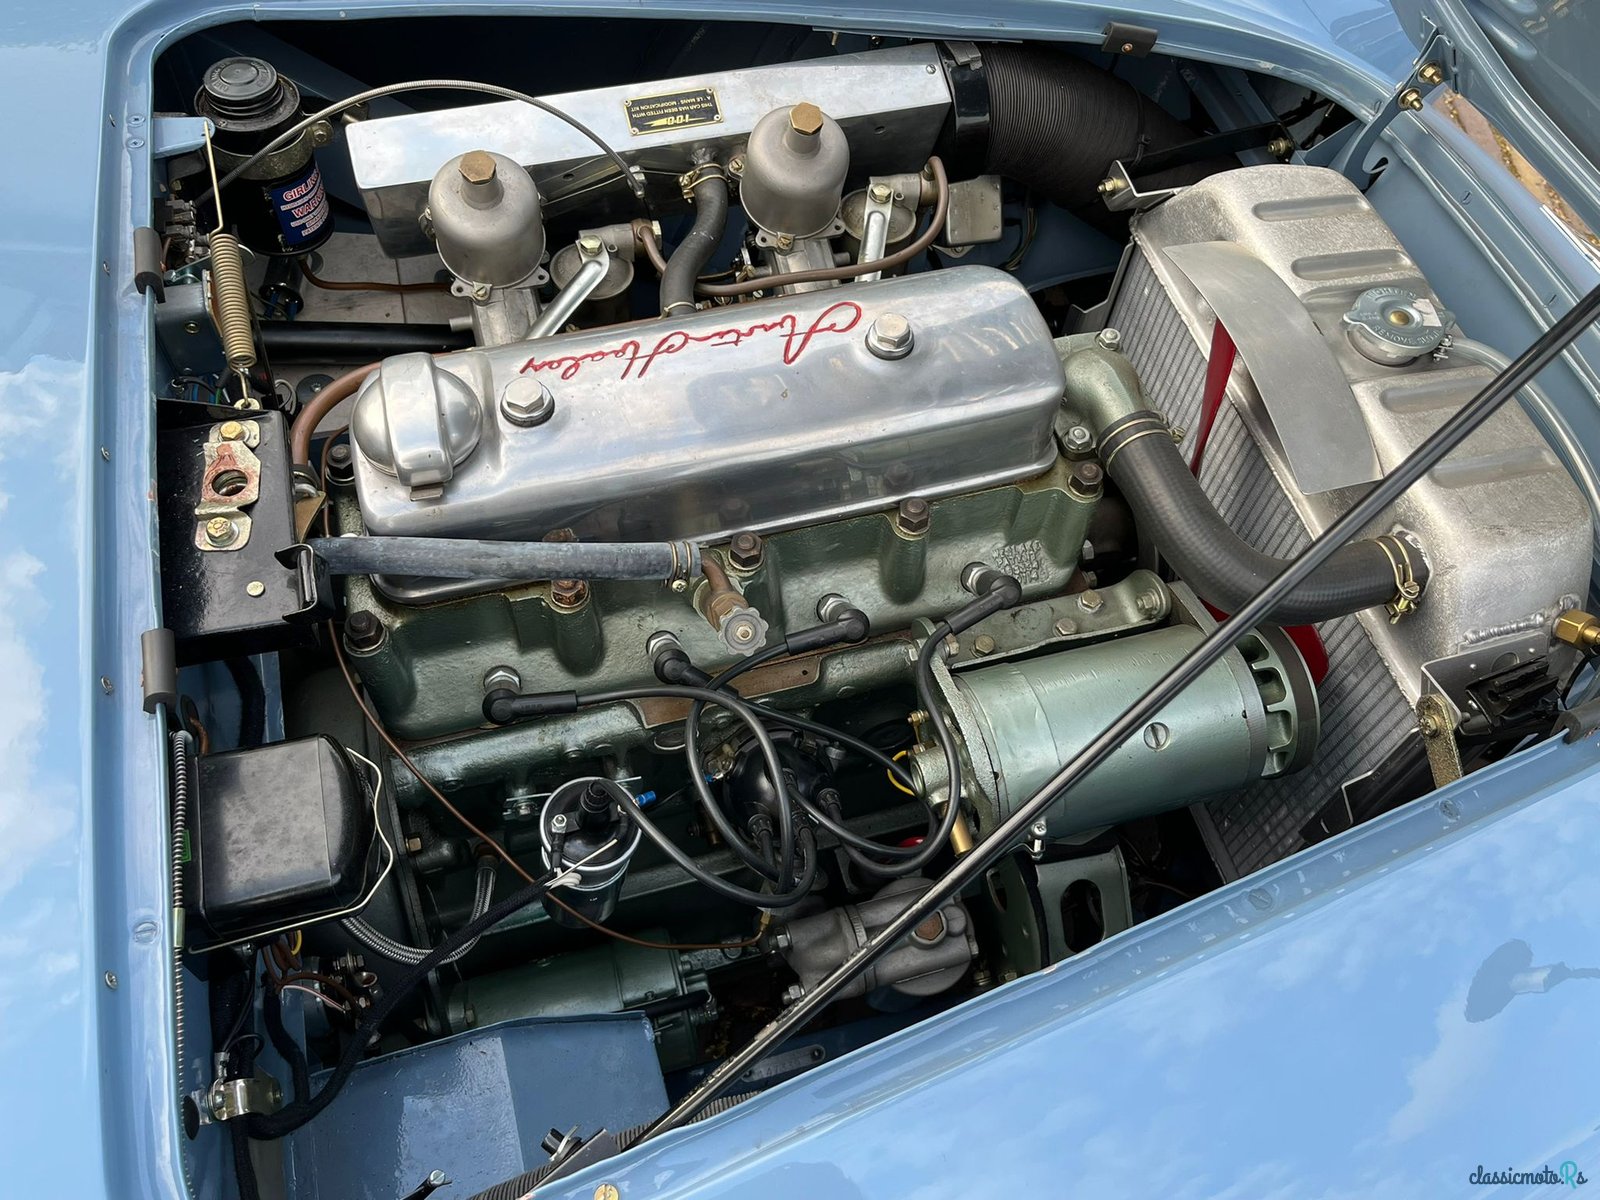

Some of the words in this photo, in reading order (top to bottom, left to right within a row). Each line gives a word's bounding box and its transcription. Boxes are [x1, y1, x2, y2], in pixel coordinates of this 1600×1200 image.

[640, 100, 677, 110] MODIFICATION
[292, 183, 325, 218] WARN
[1374, 325, 1415, 346] REMOVE
